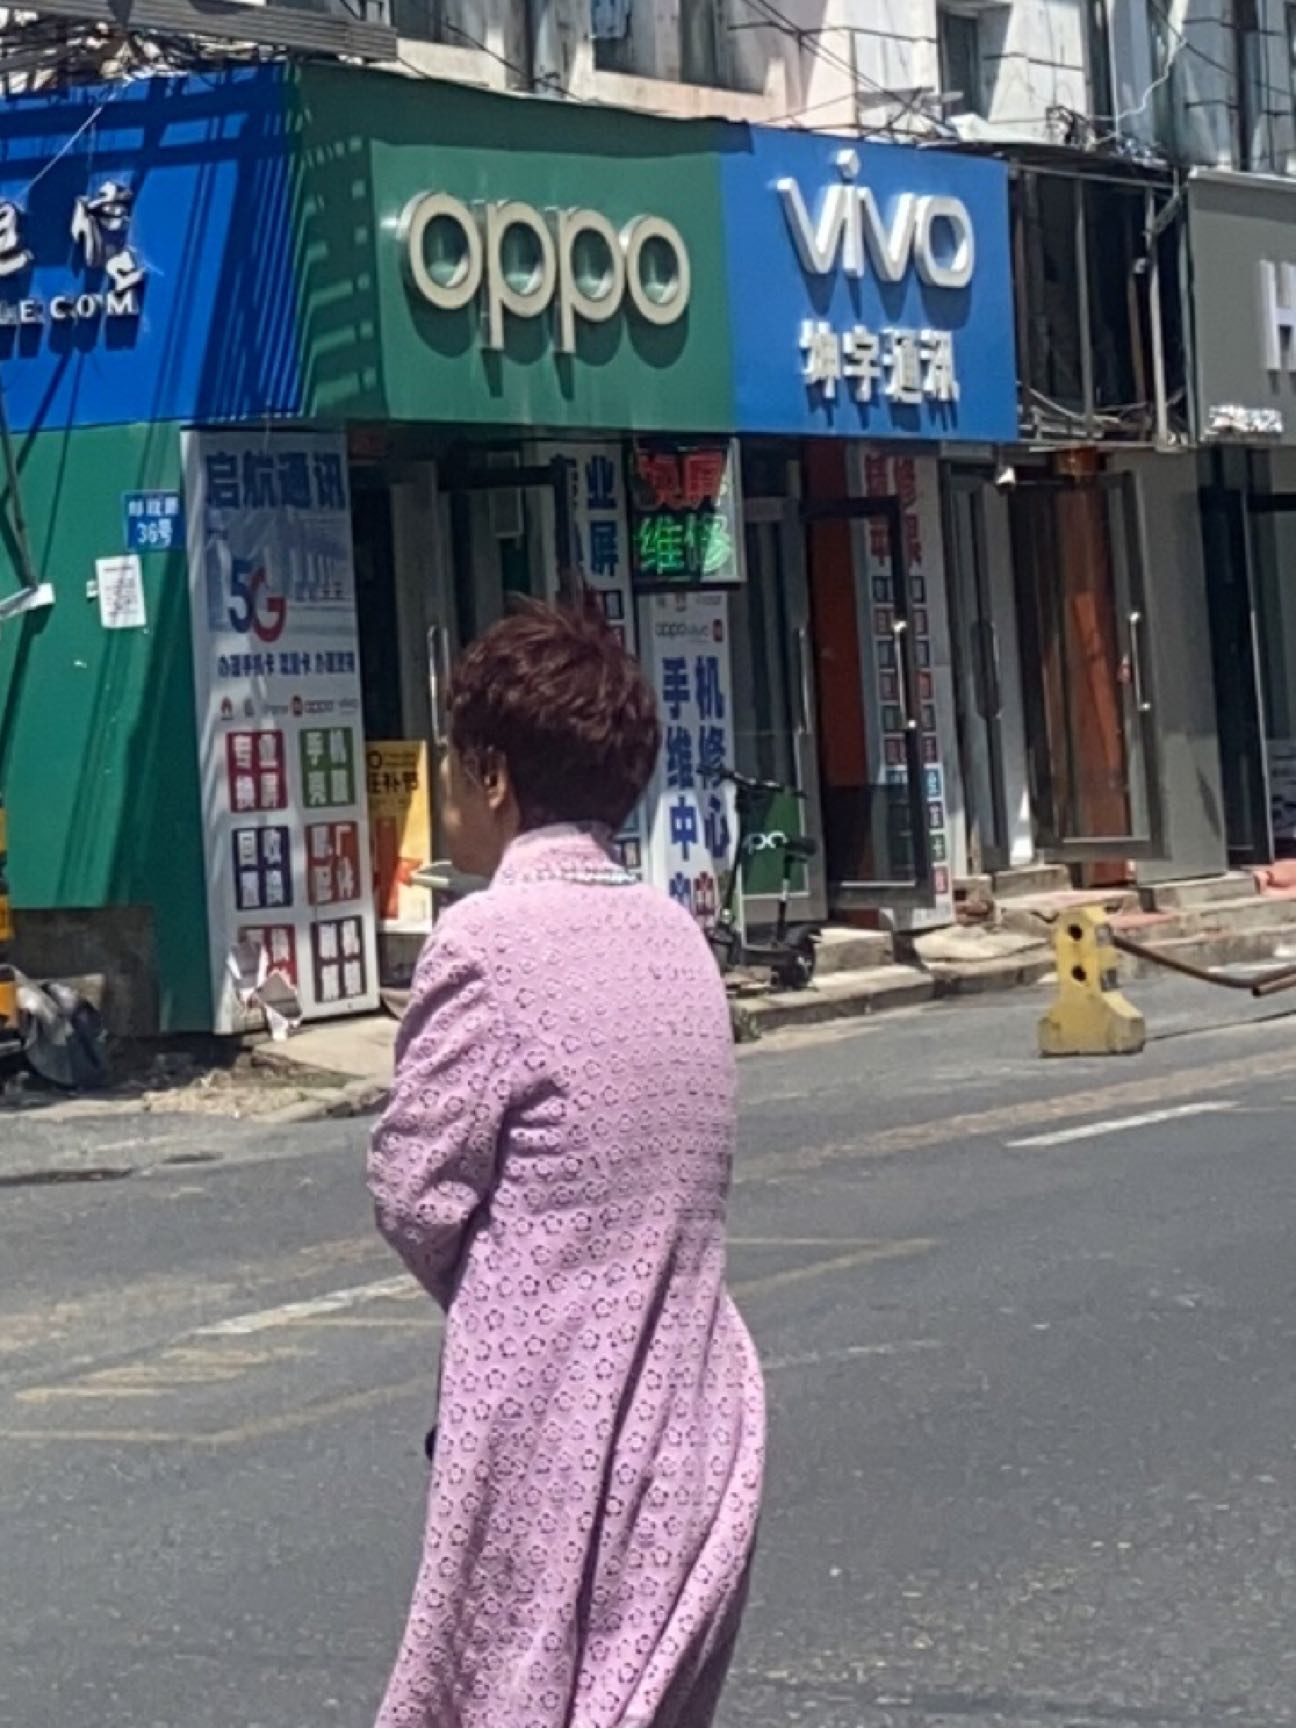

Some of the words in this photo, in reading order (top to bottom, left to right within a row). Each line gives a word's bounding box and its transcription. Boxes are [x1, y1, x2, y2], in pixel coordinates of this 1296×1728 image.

[401, 191, 691, 354] oppo
[777, 149, 976, 289] vivo
[229, 559, 287, 643] 5G
